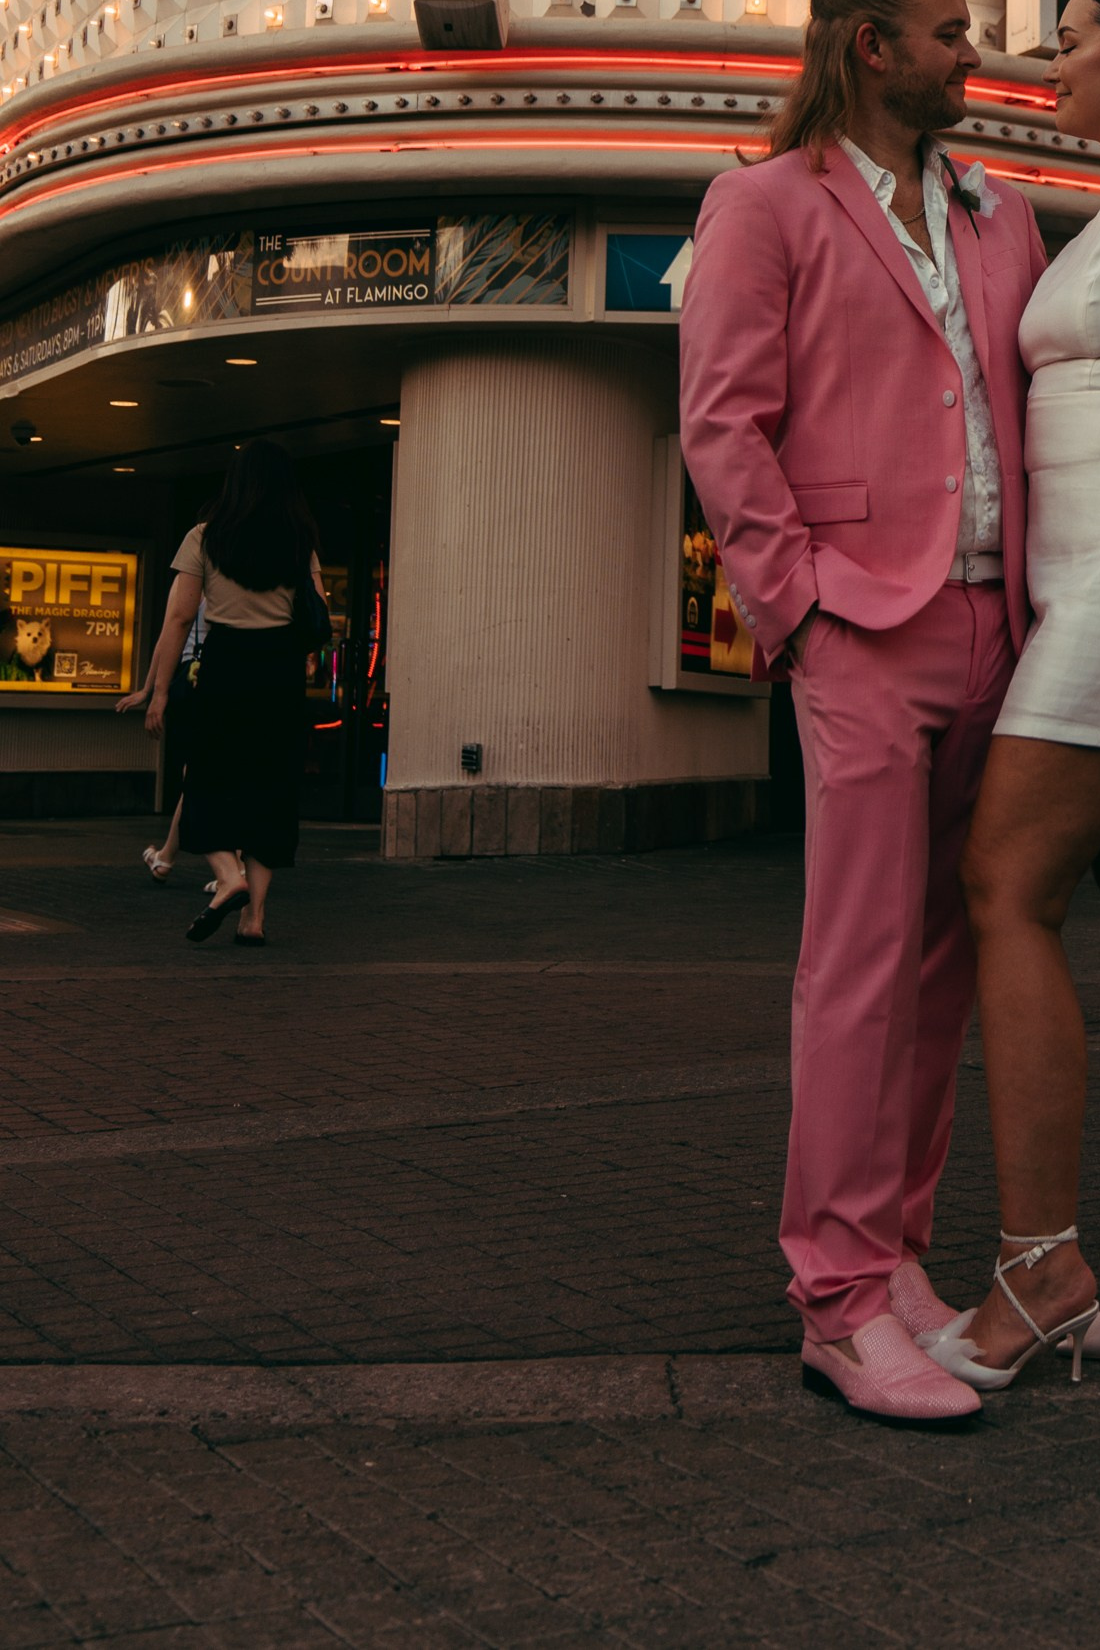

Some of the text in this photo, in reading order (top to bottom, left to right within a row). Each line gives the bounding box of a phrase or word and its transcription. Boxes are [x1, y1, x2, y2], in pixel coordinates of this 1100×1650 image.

[259, 234, 283, 252] THE
[344, 248, 430, 280] ROOM
[325, 283, 428, 305] AT FLAMINGO
[13, 353, 19, 373] &
[62, 324, 80, 350] 8PM
[10, 560, 122, 606] PIFF
[10, 605, 120, 619] THE MAGIC DRAGON
[86, 621, 120, 636] 7PM
